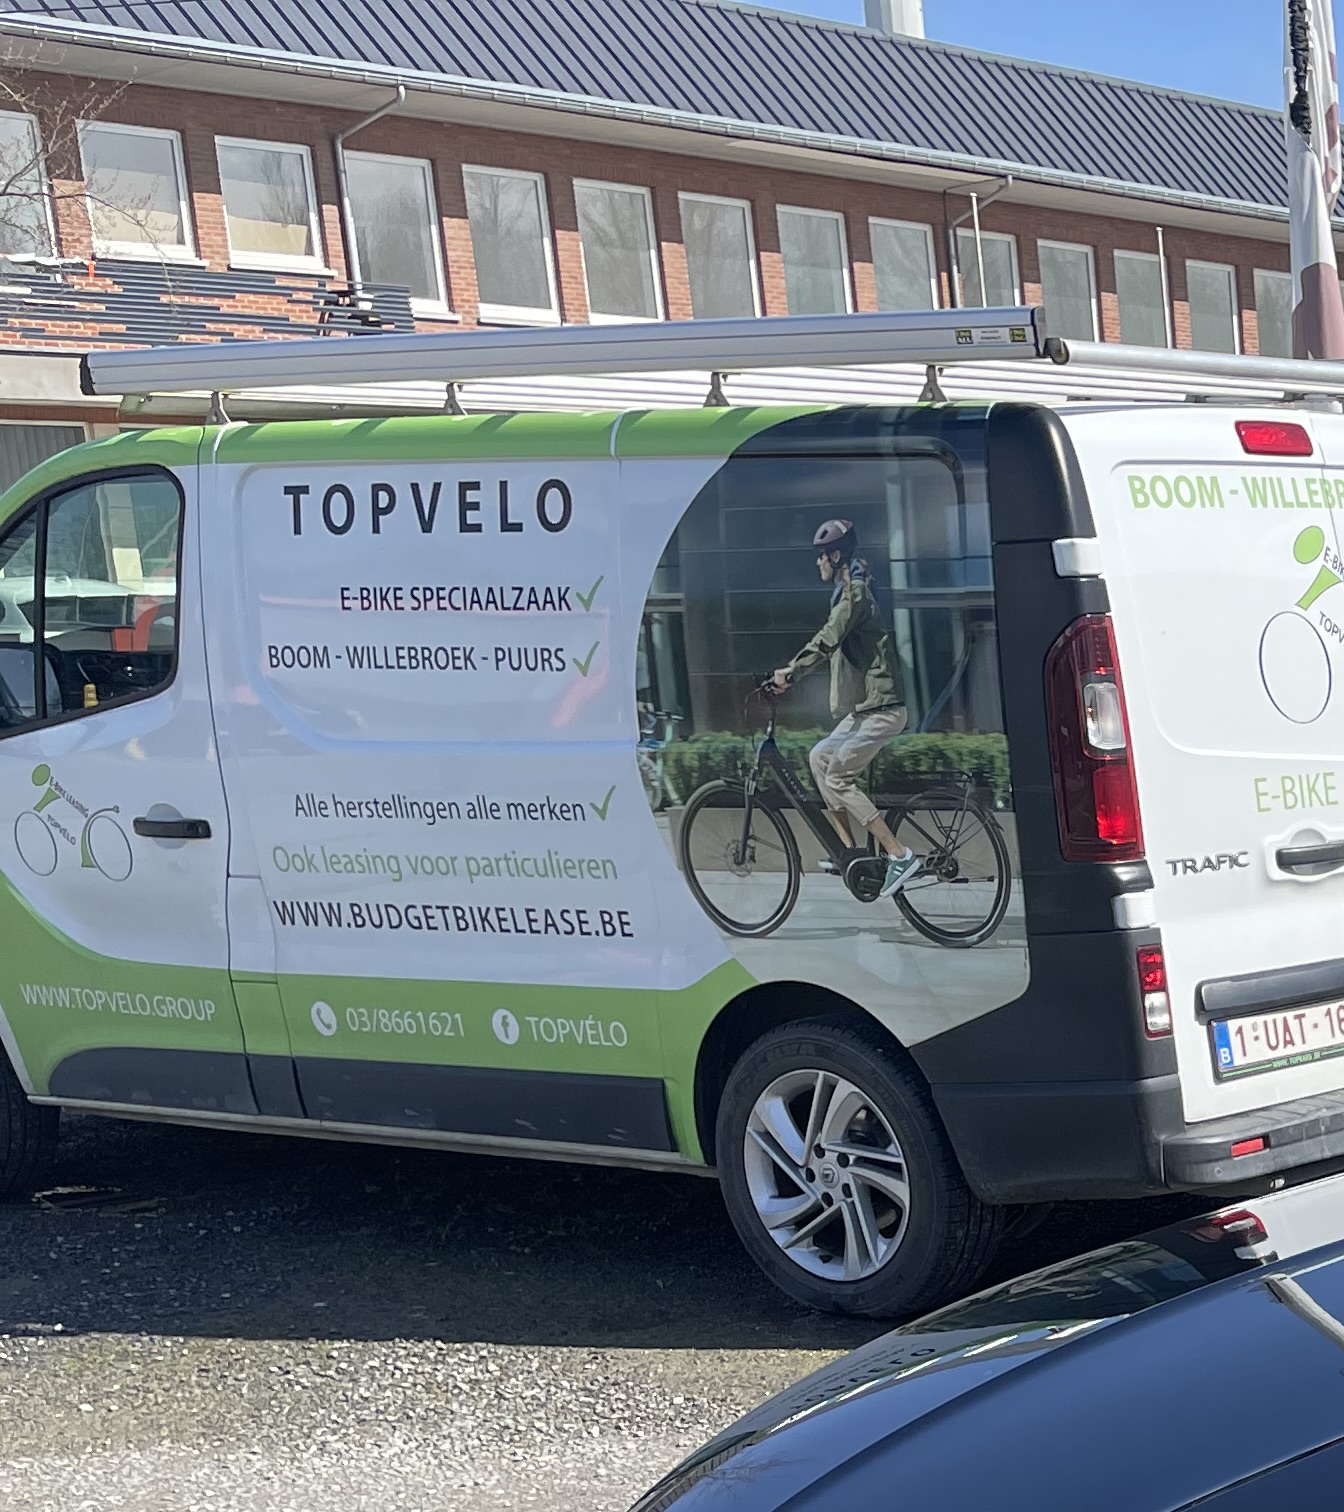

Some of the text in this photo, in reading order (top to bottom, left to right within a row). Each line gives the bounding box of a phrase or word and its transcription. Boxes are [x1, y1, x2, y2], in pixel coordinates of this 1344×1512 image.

[284, 478, 573, 536] TOPVELO
[1127, 474, 1225, 509] BOOM
[341, 586, 572, 612] E-BIKE SPECIAALZAAK
[268, 645, 332, 669] BOOM
[345, 646, 477, 671] WILLEBROEK
[495, 647, 566, 672] PUURS
[1254, 772, 1339, 813] E-BIKE
[295, 793, 586, 826] Alle herstellingen alle merken
[272, 845, 618, 884] Ook leasing voor particulieren
[1166, 851, 1250, 877] TRAFIC
[273, 900, 635, 938] WWW.BUDGETBIKELEASE.BE
[20, 983, 216, 1022] WWW.TOPVELO.GROUP
[346, 1007, 465, 1037] 03/8661621
[525, 1014, 628, 1047] TOPVÉLO
[1220, 1047, 1231, 1064] B
